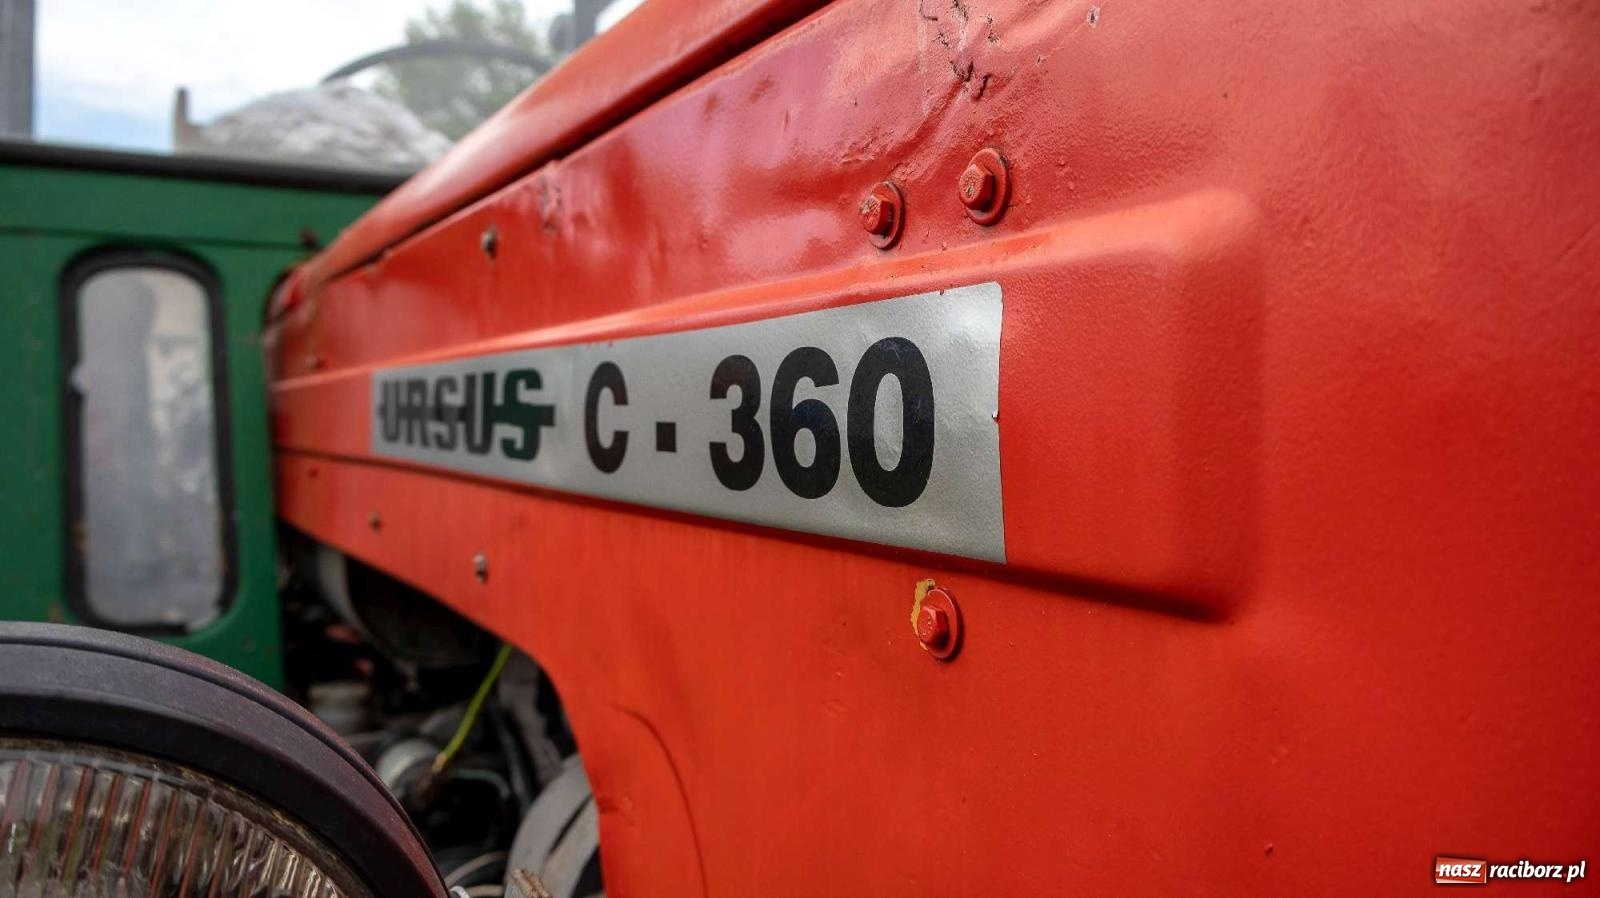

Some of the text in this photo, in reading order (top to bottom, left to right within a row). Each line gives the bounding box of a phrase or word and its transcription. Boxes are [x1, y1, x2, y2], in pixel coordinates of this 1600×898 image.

[377, 368, 555, 461] URSUS
[585, 361, 629, 474] C
[709, 336, 935, 508] 360
